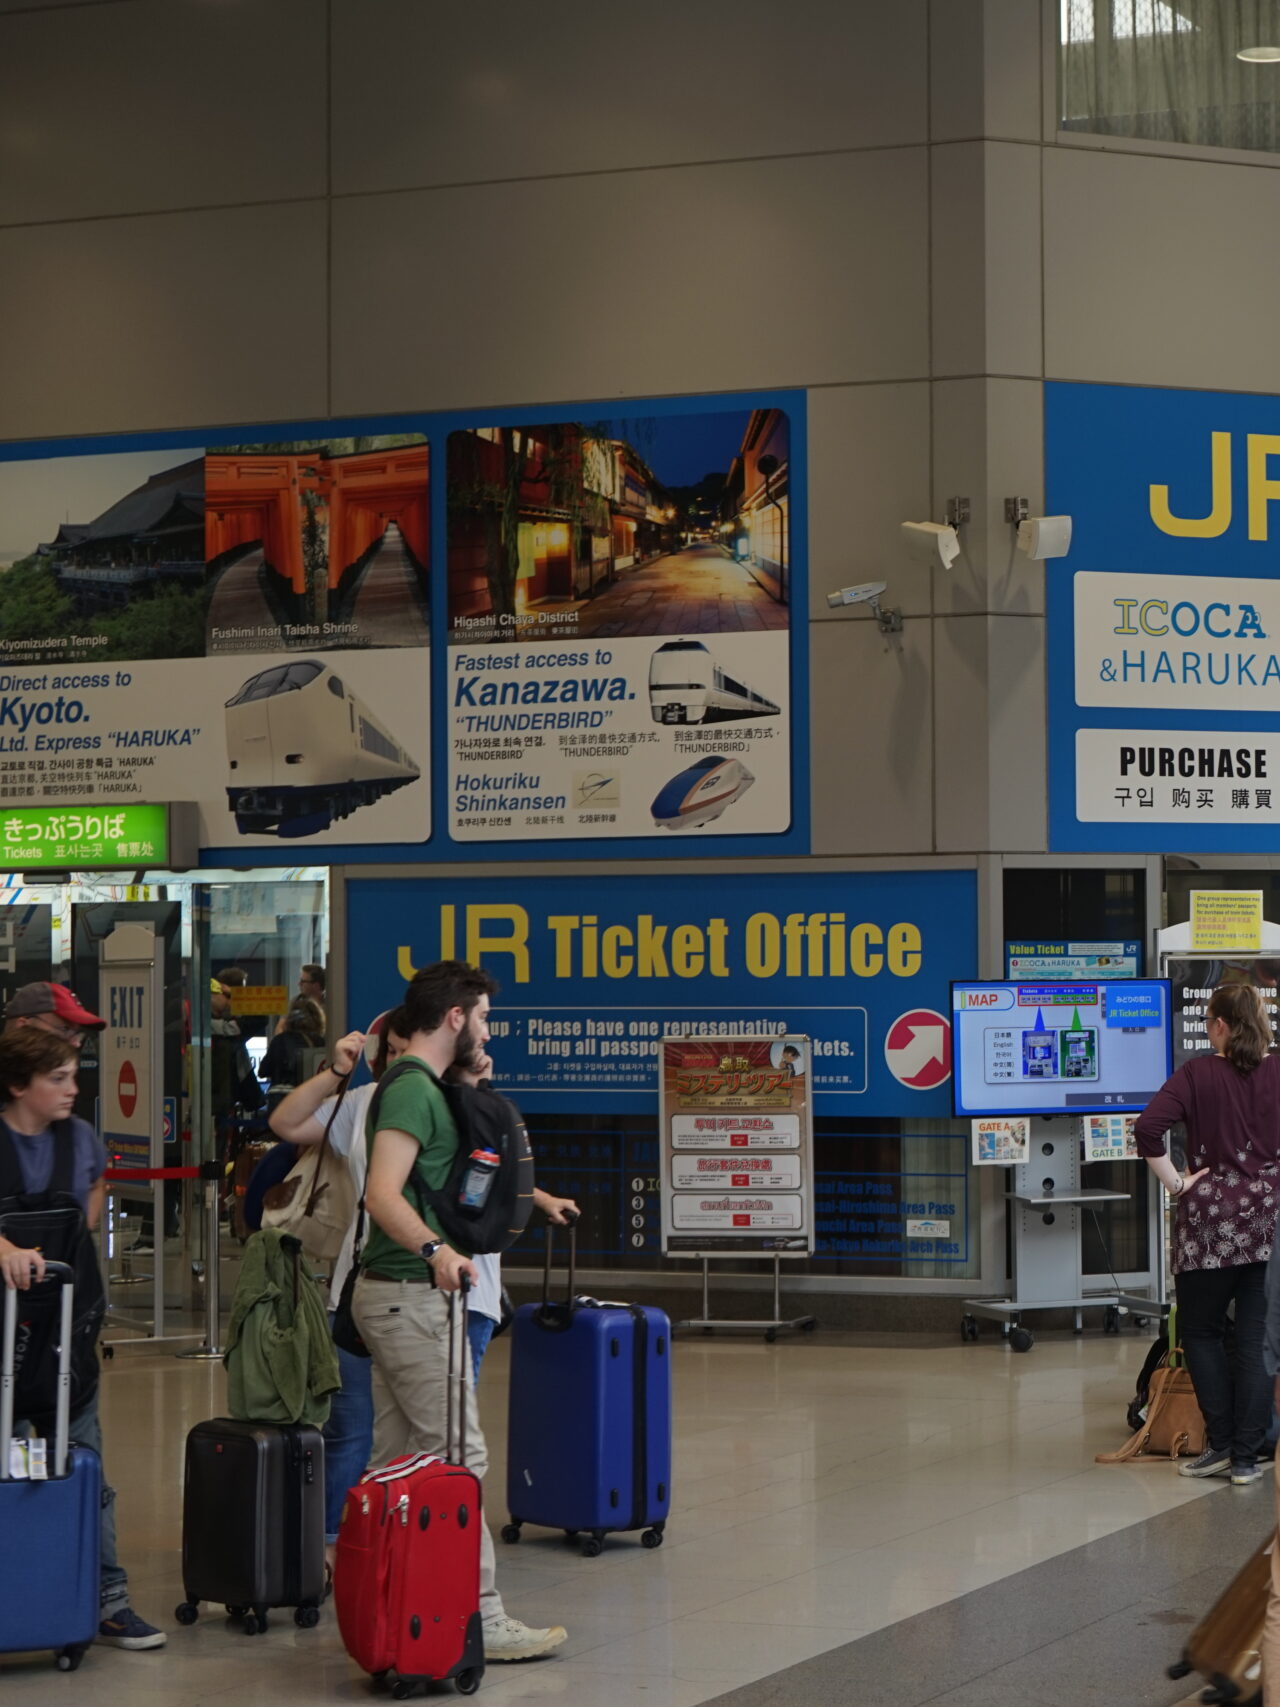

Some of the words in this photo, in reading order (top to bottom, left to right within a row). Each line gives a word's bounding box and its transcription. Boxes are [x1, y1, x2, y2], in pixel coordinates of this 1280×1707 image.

[454, 615, 496, 629] Higashi
[500, 613, 534, 626] Chaya
[538, 611, 579, 623] District
[1113, 599, 1267, 638] ICOCA
[211, 625, 254, 639] Fushimi
[257, 624, 282, 637] Inari
[284, 623, 320, 636] Taisha
[323, 622, 358, 635] Shrine
[0, 637, 67, 652] Kiyomizudera
[70, 634, 108, 647] Temple
[454, 654, 521, 672] Fastest
[525, 652, 590, 668] access
[595, 649, 612, 665] to
[0, 674, 48, 692] Direct
[52, 676, 109, 690] access
[116, 672, 131, 687] to
[454, 676, 636, 707] Kanazawa.
[0, 697, 90, 732] Kyoto.
[456, 710, 613, 733] “THUNDERBIRD”
[0, 736, 29, 753] Ltd.
[34, 735, 101, 754] Express
[107, 728, 200, 748] “HARUKA”
[454, 737, 501, 749] 가나자와로
[49, 759, 74, 770] 간사이
[1120, 747, 1267, 778] PURCHASE
[455, 772, 540, 791] Hokuriku
[455, 795, 566, 812] Shinkansen
[1114, 787, 1154, 807] 구입
[1172, 787, 1214, 808] 购买
[1231, 788, 1272, 809] 購買
[4, 813, 126, 842] きっぷうりば
[3, 846, 43, 859] Tickets
[54, 843, 103, 858] 표사는곳
[116, 842, 154, 858] 售票处
[397, 904, 530, 983] JR
[547, 914, 729, 978] Ticket
[745, 912, 922, 978] Office
[1009, 944, 1035, 955] Value
[1037, 944, 1064, 955] Ticket
[1126, 944, 1136, 952] JR
[1051, 959, 1081, 967] HARUKA
[968, 993, 998, 1006] MAP
[1183, 986, 1212, 999] Group
[110, 986, 144, 1028] EXIT
[1109, 1009, 1118, 1017] JR
[1119, 1009, 1139, 1017] Ticket
[1141, 1009, 1159, 1017] Office
[1183, 1004, 1201, 1015] one
[528, 1018, 581, 1037] Please
[586, 1018, 624, 1037] have
[628, 1020, 658, 1037] one
[663, 1019, 787, 1036] representative
[528, 1038, 570, 1058] bring
[575, 1038, 596, 1056] all
[1183, 1039, 1194, 1050] to
[677, 1073, 792, 1095] ミステリーツアー
[979, 1122, 1002, 1132] GATE
[1003, 1122, 1011, 1131] A
[1092, 1149, 1115, 1158] GATE
[1117, 1148, 1123, 1157] B
[900, 1202, 926, 1215] Area
[928, 1202, 955, 1215] Pass
[935, 1240, 960, 1255] Pass
